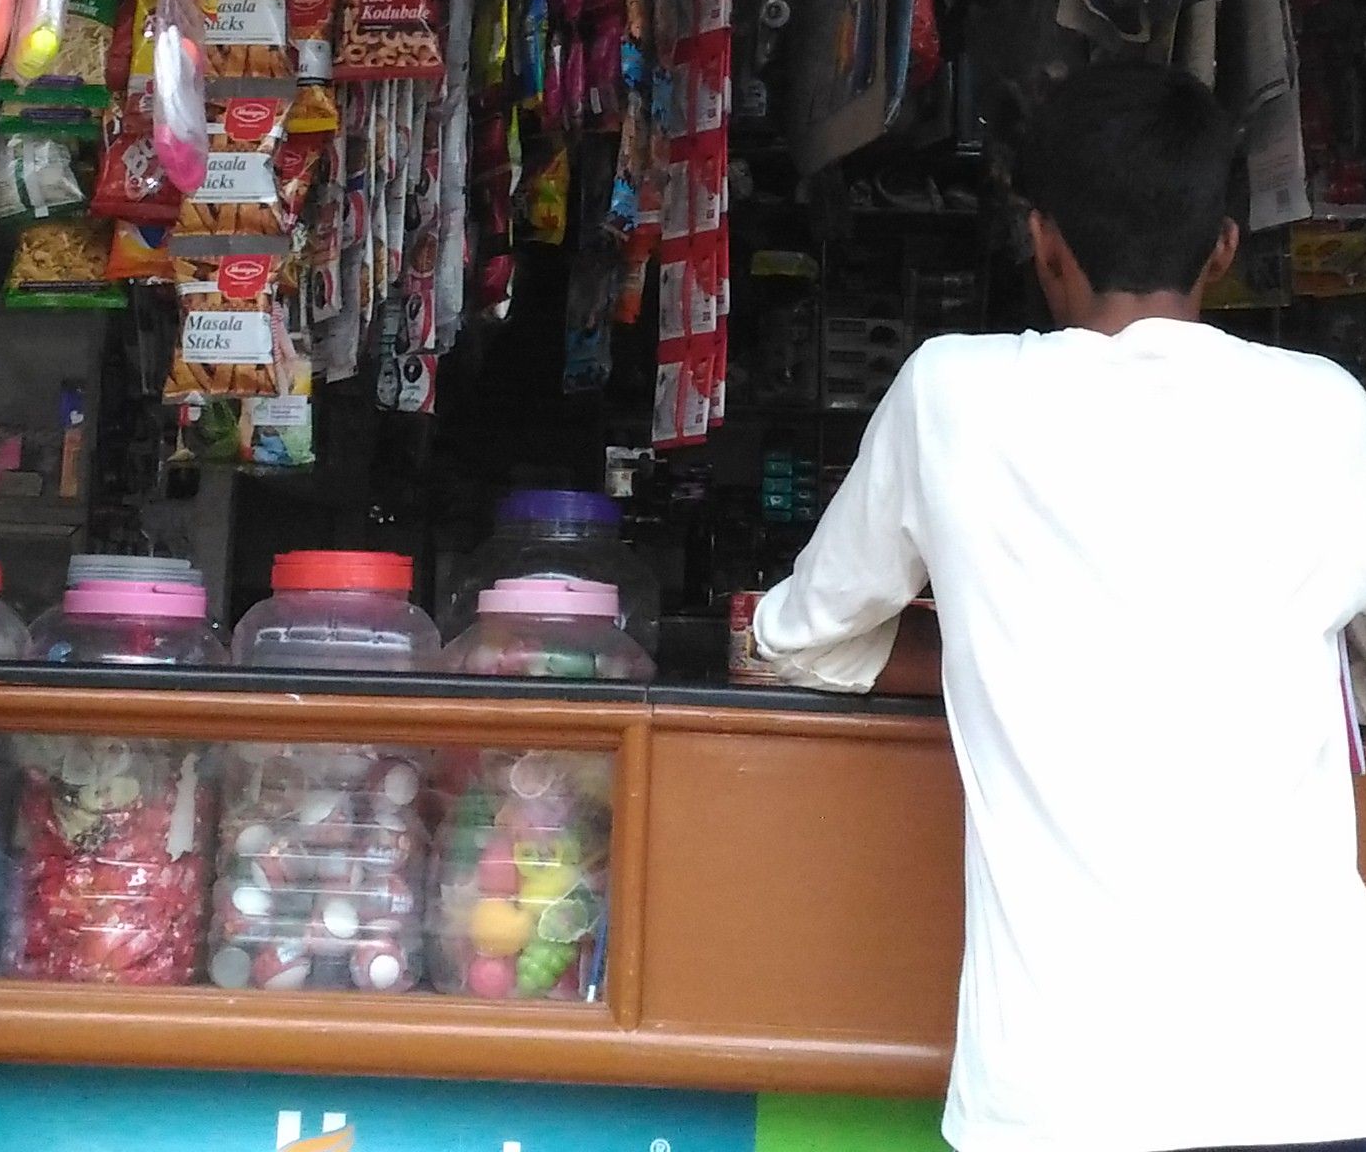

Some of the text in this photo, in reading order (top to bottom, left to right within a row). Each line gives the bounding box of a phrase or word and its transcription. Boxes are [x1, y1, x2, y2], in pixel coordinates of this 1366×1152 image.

[217, 0, 256, 14] asala
[361, 3, 431, 20] Kodubale
[208, 156, 247, 171] asala
[201, 173, 235, 189] icks
[186, 316, 243, 331] Masala
[186, 333, 232, 350] Sticks
